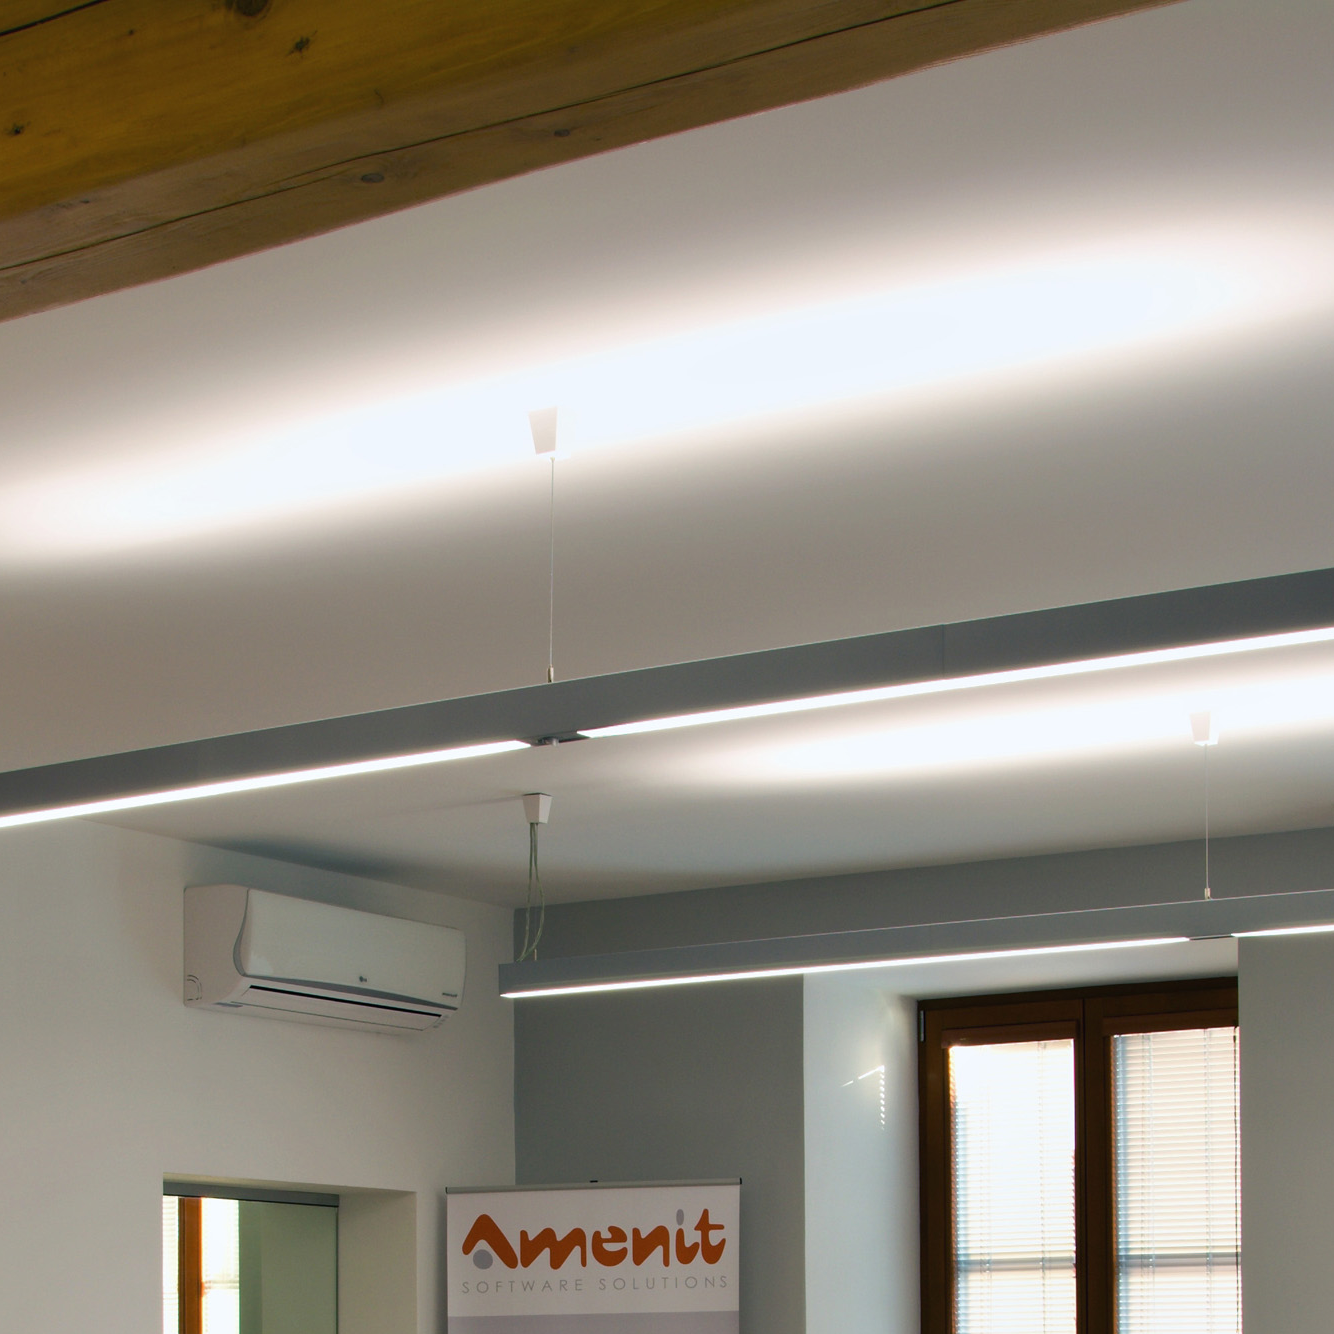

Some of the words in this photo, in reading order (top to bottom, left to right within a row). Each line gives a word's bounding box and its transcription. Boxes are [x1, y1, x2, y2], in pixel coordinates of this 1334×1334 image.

[462, 1208, 727, 1270] Amenit
[461, 1279, 584, 1294] SOFTWARE
[598, 1275, 728, 1290] SOLUTIONS
